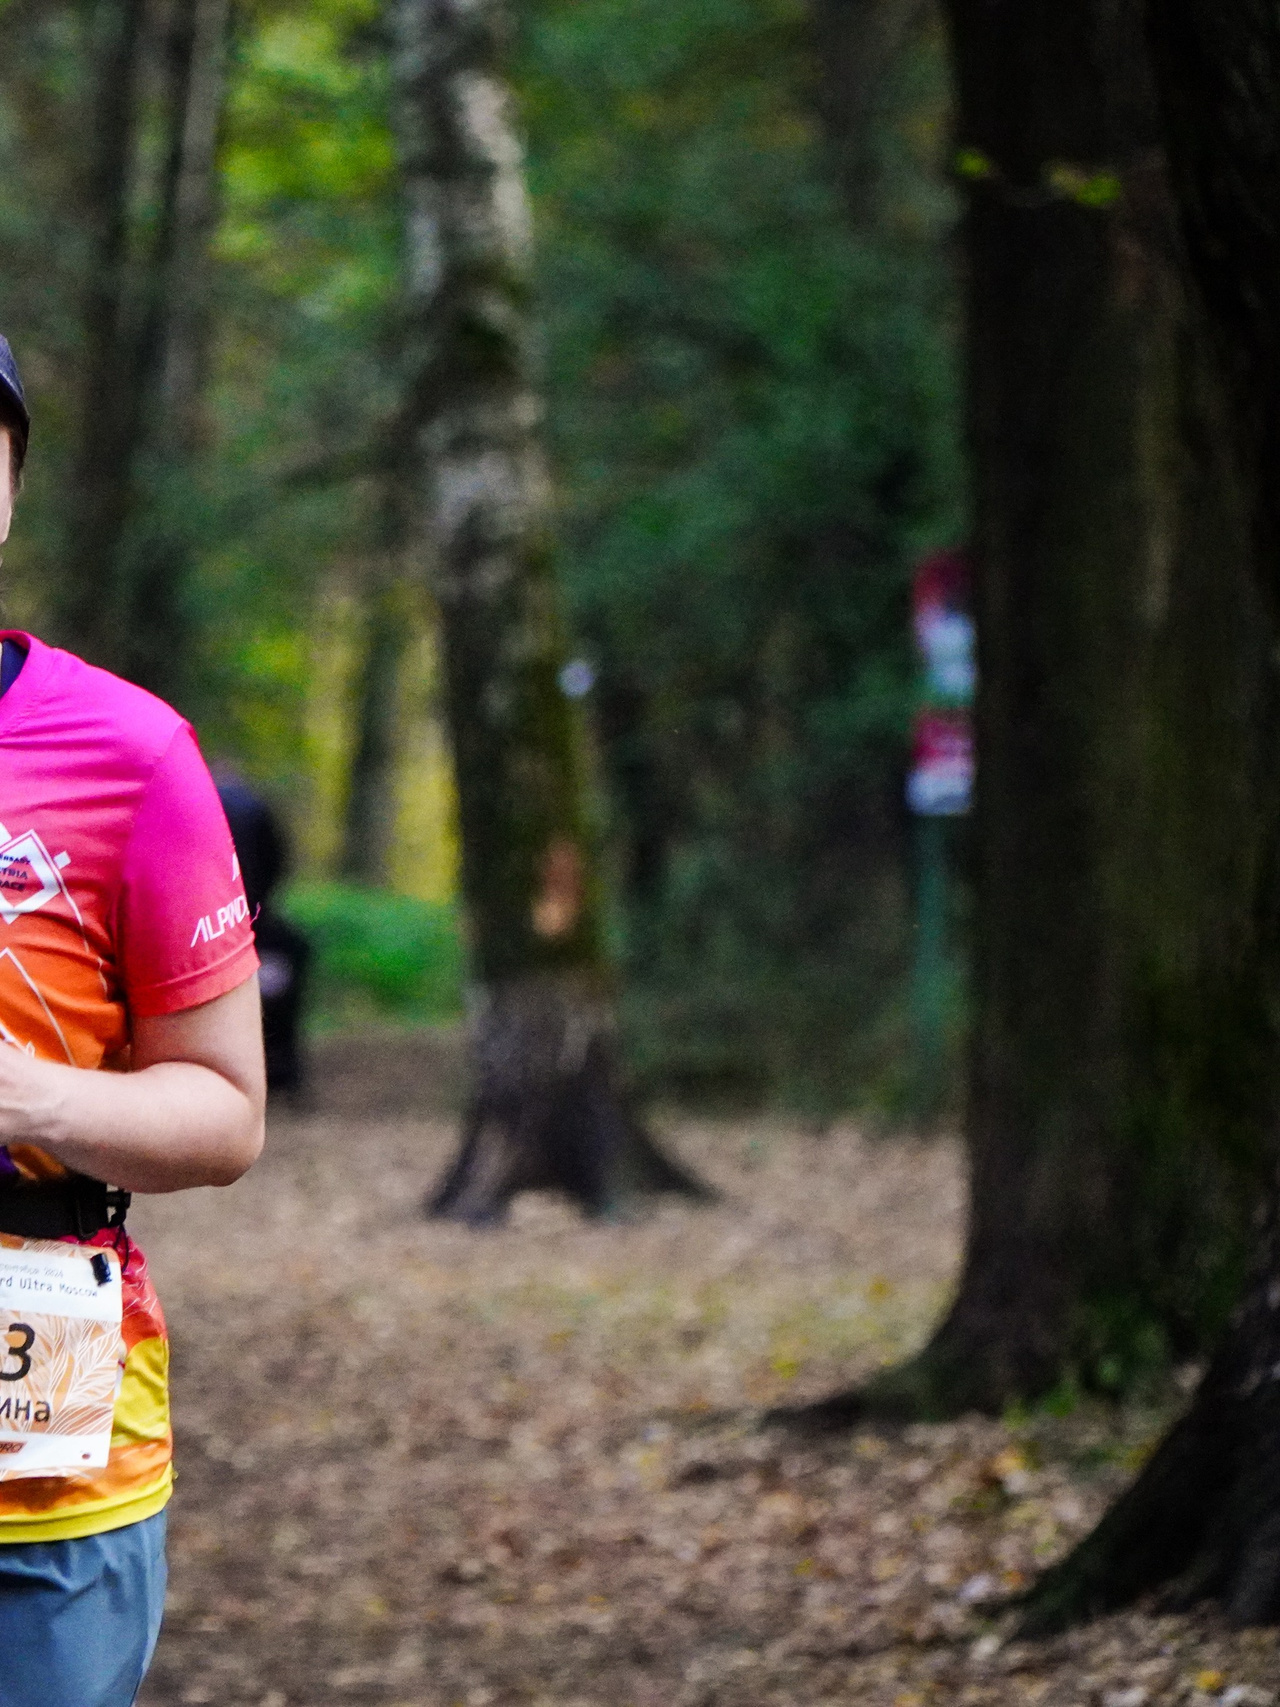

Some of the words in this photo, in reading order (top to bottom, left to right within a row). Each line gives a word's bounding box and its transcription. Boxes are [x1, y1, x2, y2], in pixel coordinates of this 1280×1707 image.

[190, 895, 250, 948] ALPIND
[20, 1278, 53, 1293] Ultra
[59, 1283, 98, 1298] Moscow
